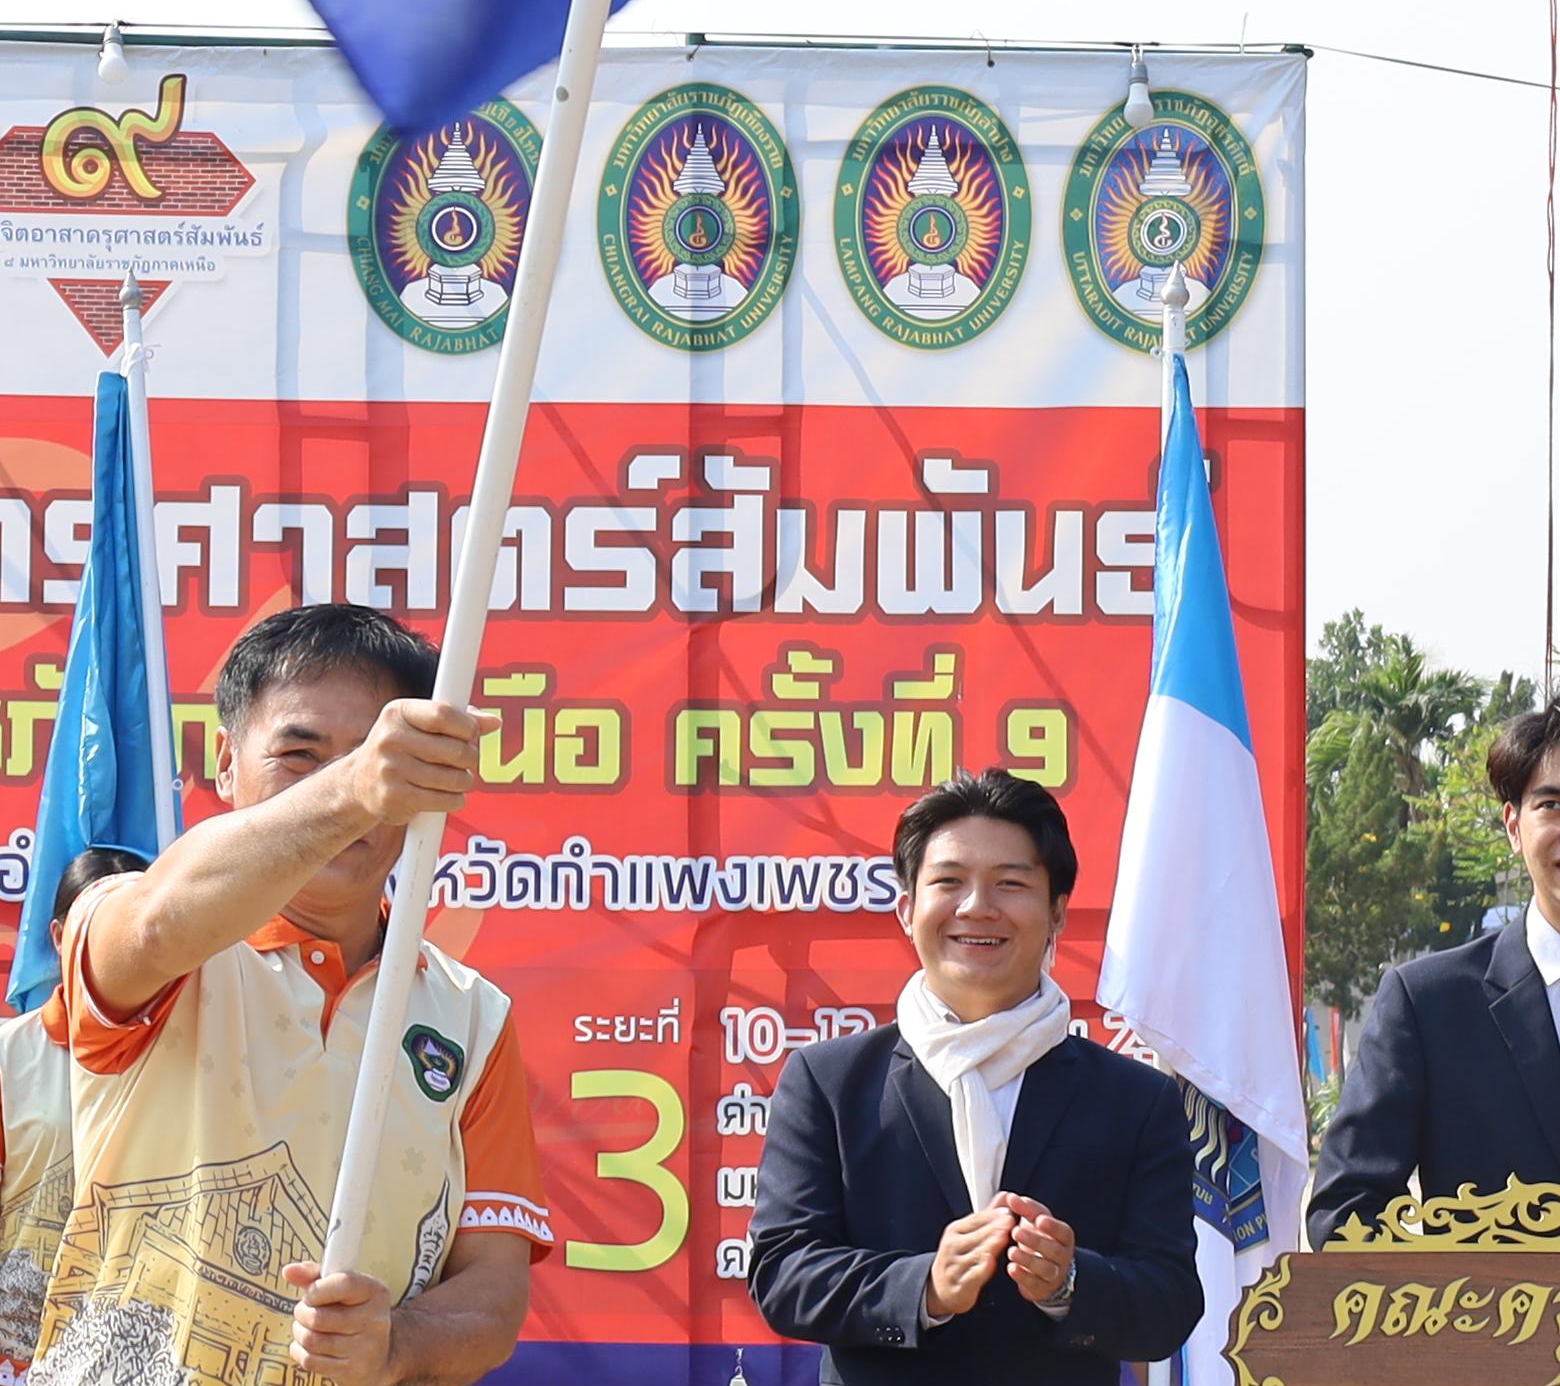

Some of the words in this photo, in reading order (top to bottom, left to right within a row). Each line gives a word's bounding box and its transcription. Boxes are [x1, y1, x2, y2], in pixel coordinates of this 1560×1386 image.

[356, 237, 383, 297] CHIANG
[378, 299, 406, 327] MAI
[409, 327, 499, 351] RAJABHAT
[603, 233, 649, 323] CHIANGRAI
[652, 320, 736, 347] RAJABHAT
[741, 235, 793, 329] UNIVERSITY
[839, 237, 882, 317] LAMPANG
[882, 317, 966, 344] RAJABHAT
[969, 241, 1025, 331] UNIVERSITY
[1072, 251, 1124, 331] UTTARADIT
[1124, 325, 1197, 350] RAJAT
[1200, 252, 1254, 332] UNIVERSITY
[674, 651, 955, 787] ครั้งที่
[574, 997, 680, 1043] ระยะที่
[565, 1069, 692, 1273] 3
